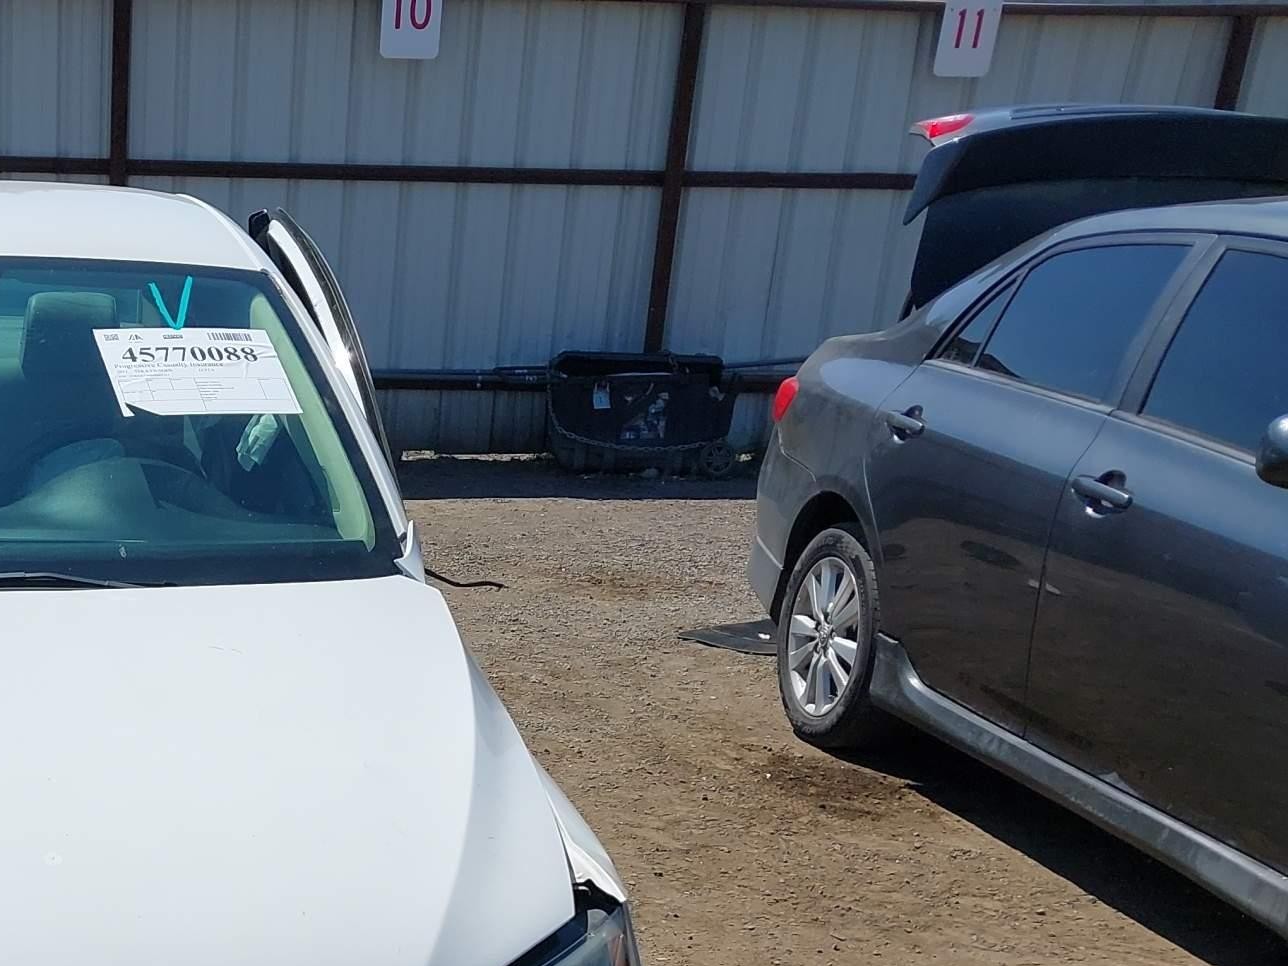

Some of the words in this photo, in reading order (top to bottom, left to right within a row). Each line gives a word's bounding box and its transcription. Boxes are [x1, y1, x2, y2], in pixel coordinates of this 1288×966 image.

[394, 0, 432, 30] 10
[954, 8, 985, 49] 11
[122, 346, 258, 363] 45770088
